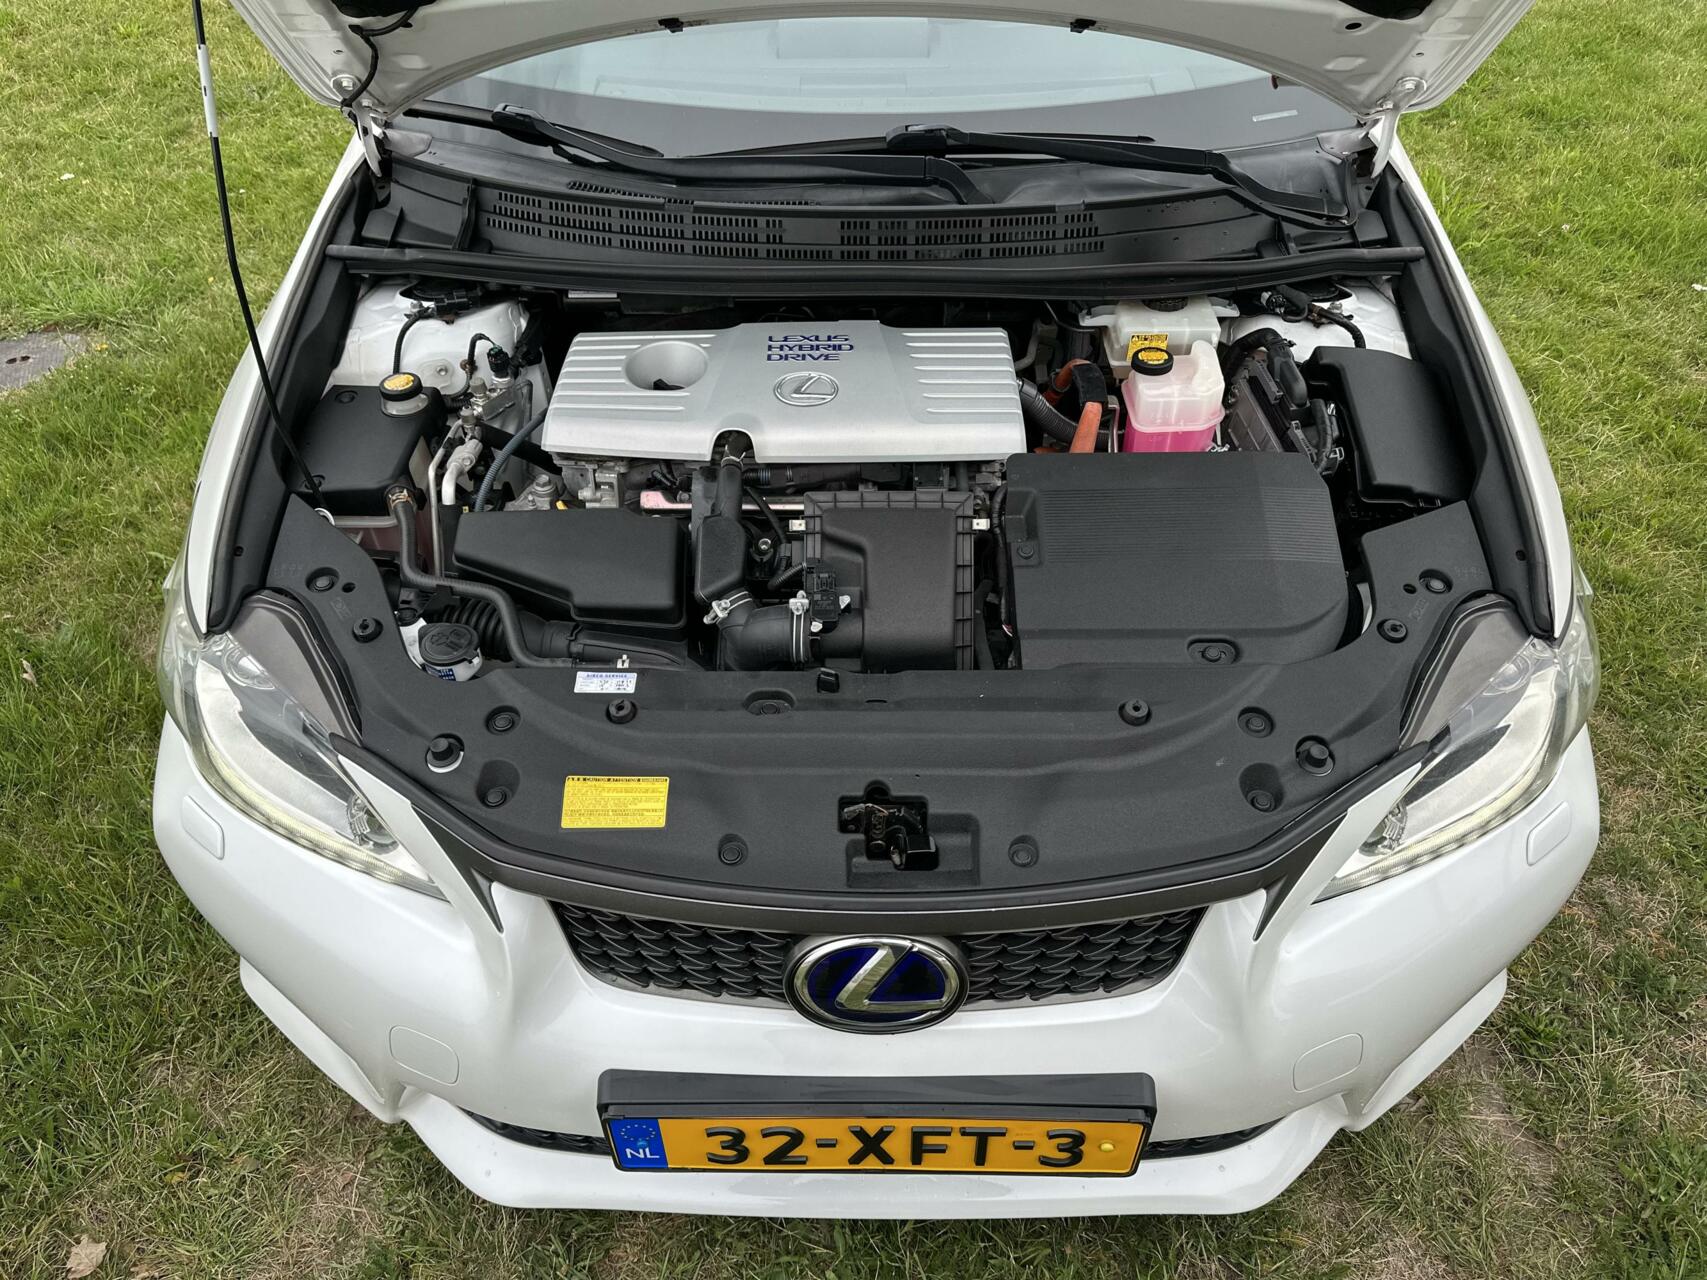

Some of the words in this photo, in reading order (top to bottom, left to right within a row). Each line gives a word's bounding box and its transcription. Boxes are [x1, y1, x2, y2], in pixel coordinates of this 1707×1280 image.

[767, 353, 840, 361] DRIVE
[705, 1125, 1087, 1168] 32-XFT-3
[625, 1147, 660, 1159] NL
